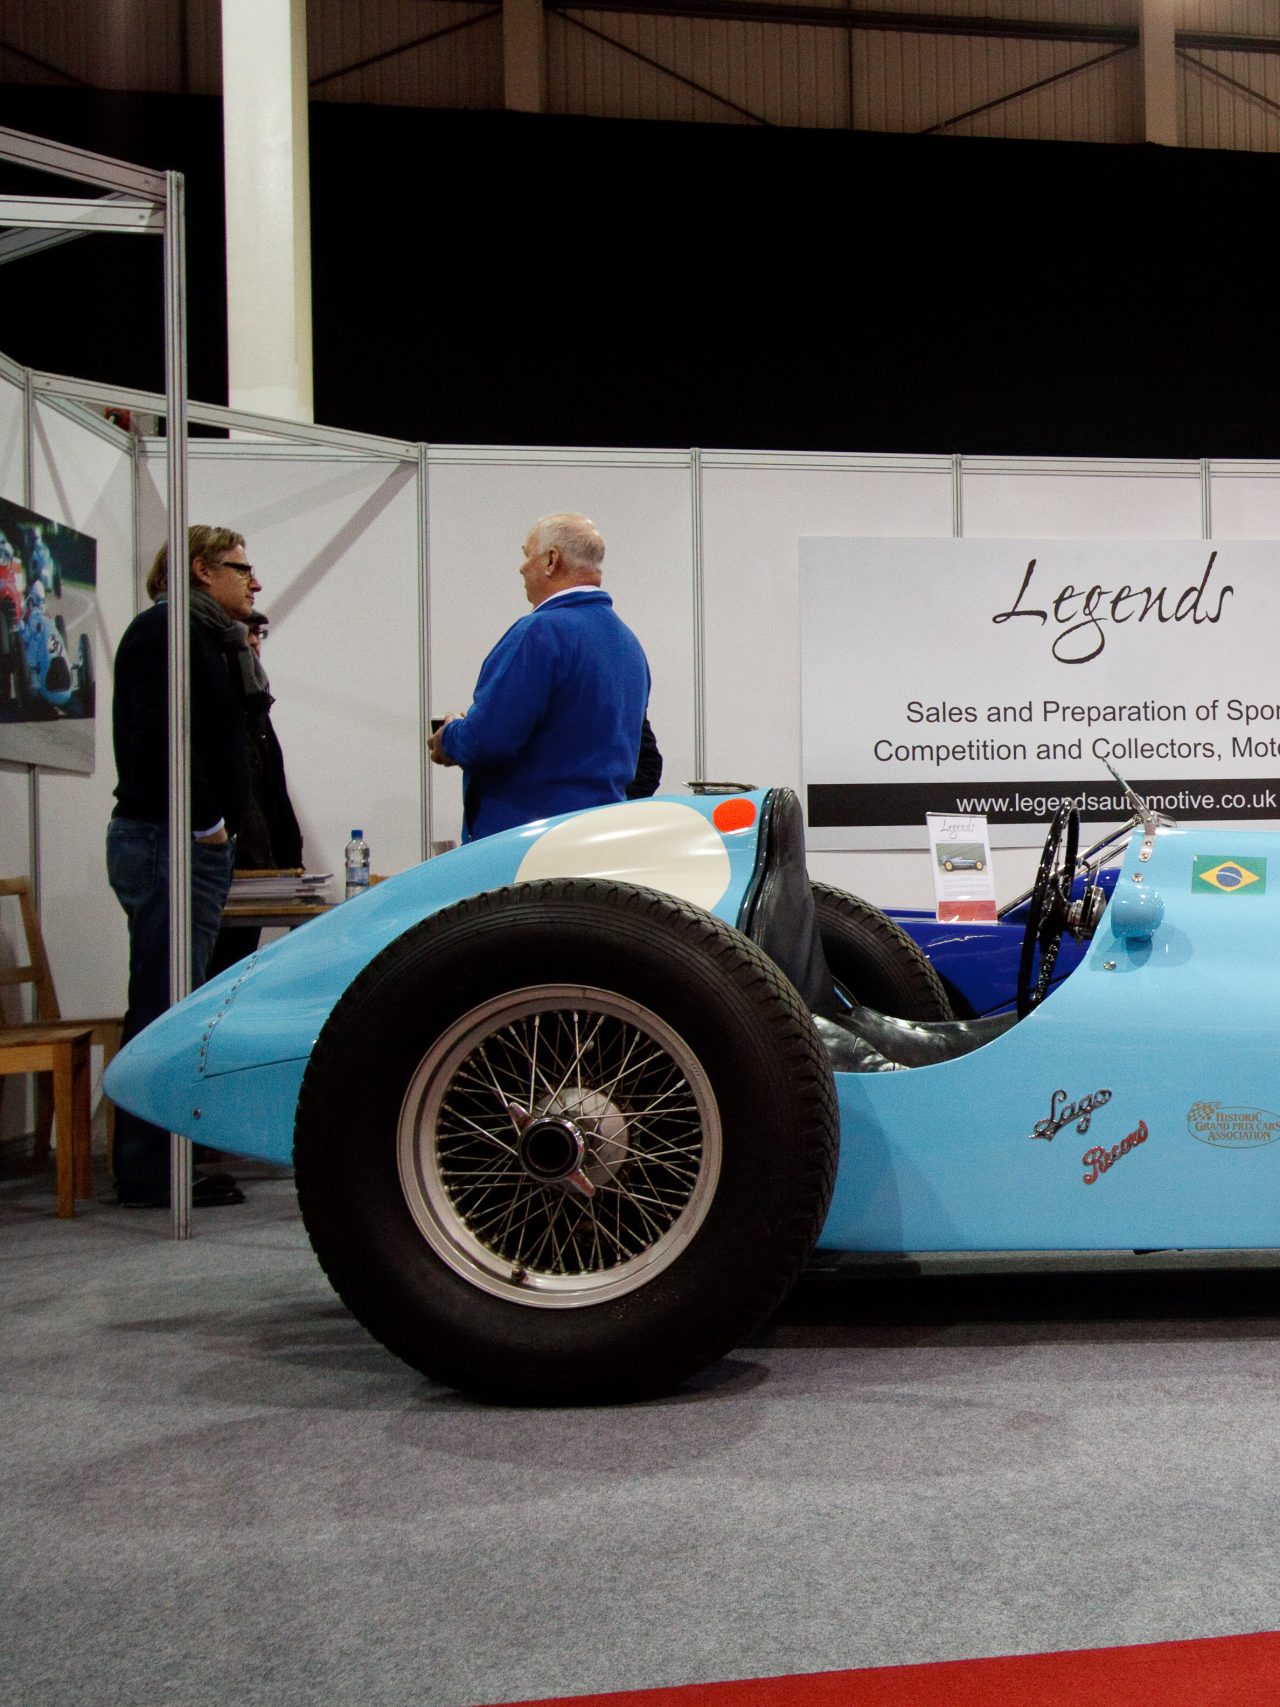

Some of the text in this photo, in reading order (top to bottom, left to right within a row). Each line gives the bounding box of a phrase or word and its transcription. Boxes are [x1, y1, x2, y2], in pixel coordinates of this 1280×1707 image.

[992, 551, 1235, 664] Legends
[906, 701, 978, 722] Sales
[986, 701, 1032, 722] and
[1043, 700, 1187, 727] Preparation
[1195, 699, 1219, 721] of
[874, 738, 1027, 766] Competition
[1036, 738, 1082, 760] and
[1092, 737, 1222, 761] Collectors,
[1028, 1089, 1113, 1142] Lago
[1195, 1121, 1230, 1131] GRAND
[1232, 1121, 1254, 1131] PRIX
[1208, 1131, 1271, 1141] ASSOCIATION
